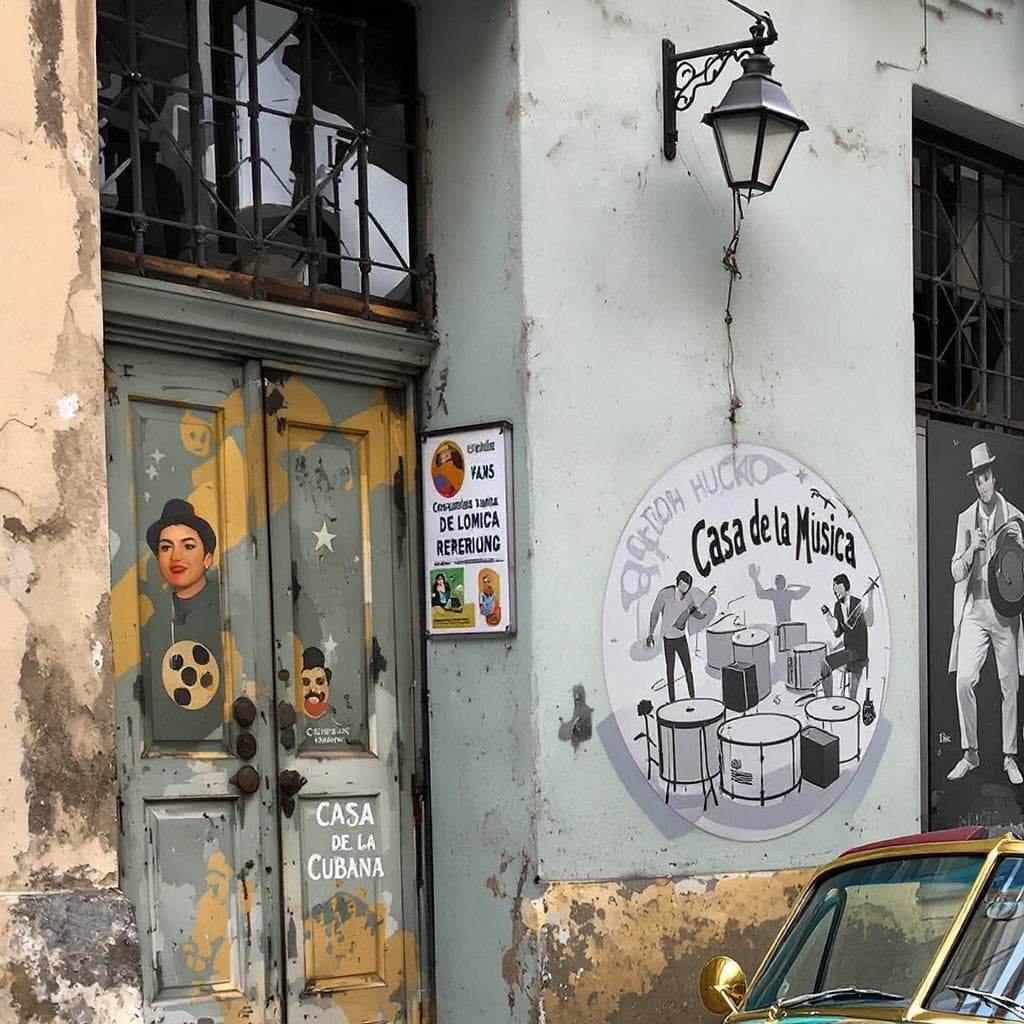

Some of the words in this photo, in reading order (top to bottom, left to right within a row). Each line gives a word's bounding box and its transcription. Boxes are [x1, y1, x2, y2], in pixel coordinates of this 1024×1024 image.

[440, 515, 454, 532] DE
[458, 511, 500, 531] LOMICA
[691, 519, 747, 577] Casa
[750, 498, 771, 546] de
[775, 505, 791, 546] la
[316, 801, 375, 827] CASA
[331, 834, 352, 851] DE
[358, 833, 376, 851] LA
[307, 853, 384, 881] CUBANA
